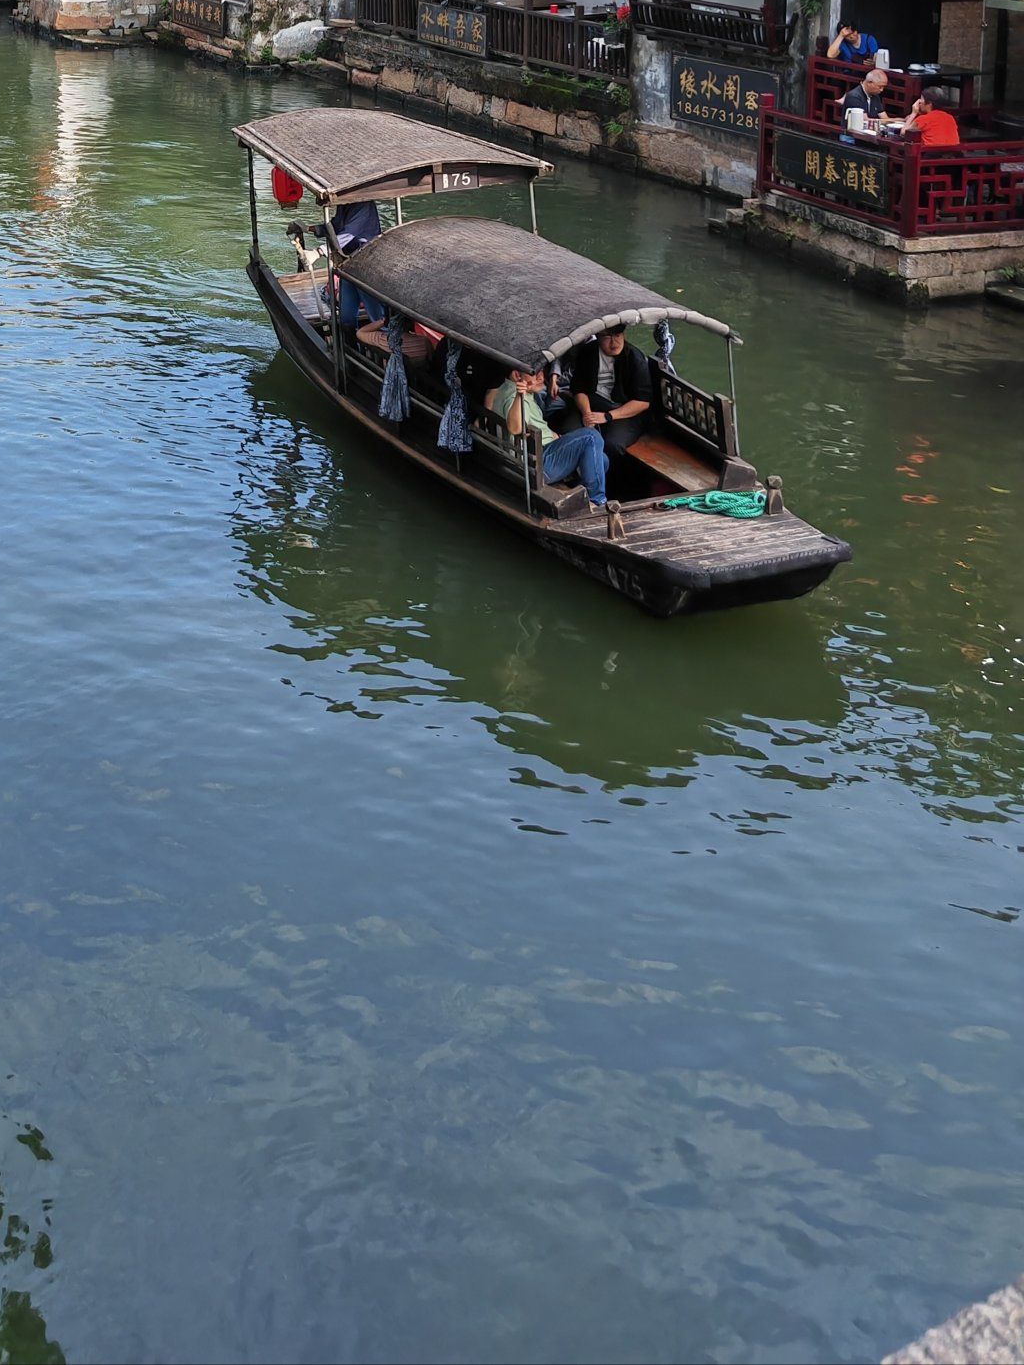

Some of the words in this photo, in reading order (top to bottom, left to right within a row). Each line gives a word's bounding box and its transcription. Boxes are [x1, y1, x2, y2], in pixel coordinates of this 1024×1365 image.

[421, 6, 482, 42] 水畔吾家
[805, 150, 880, 198] 開泰酒樓
